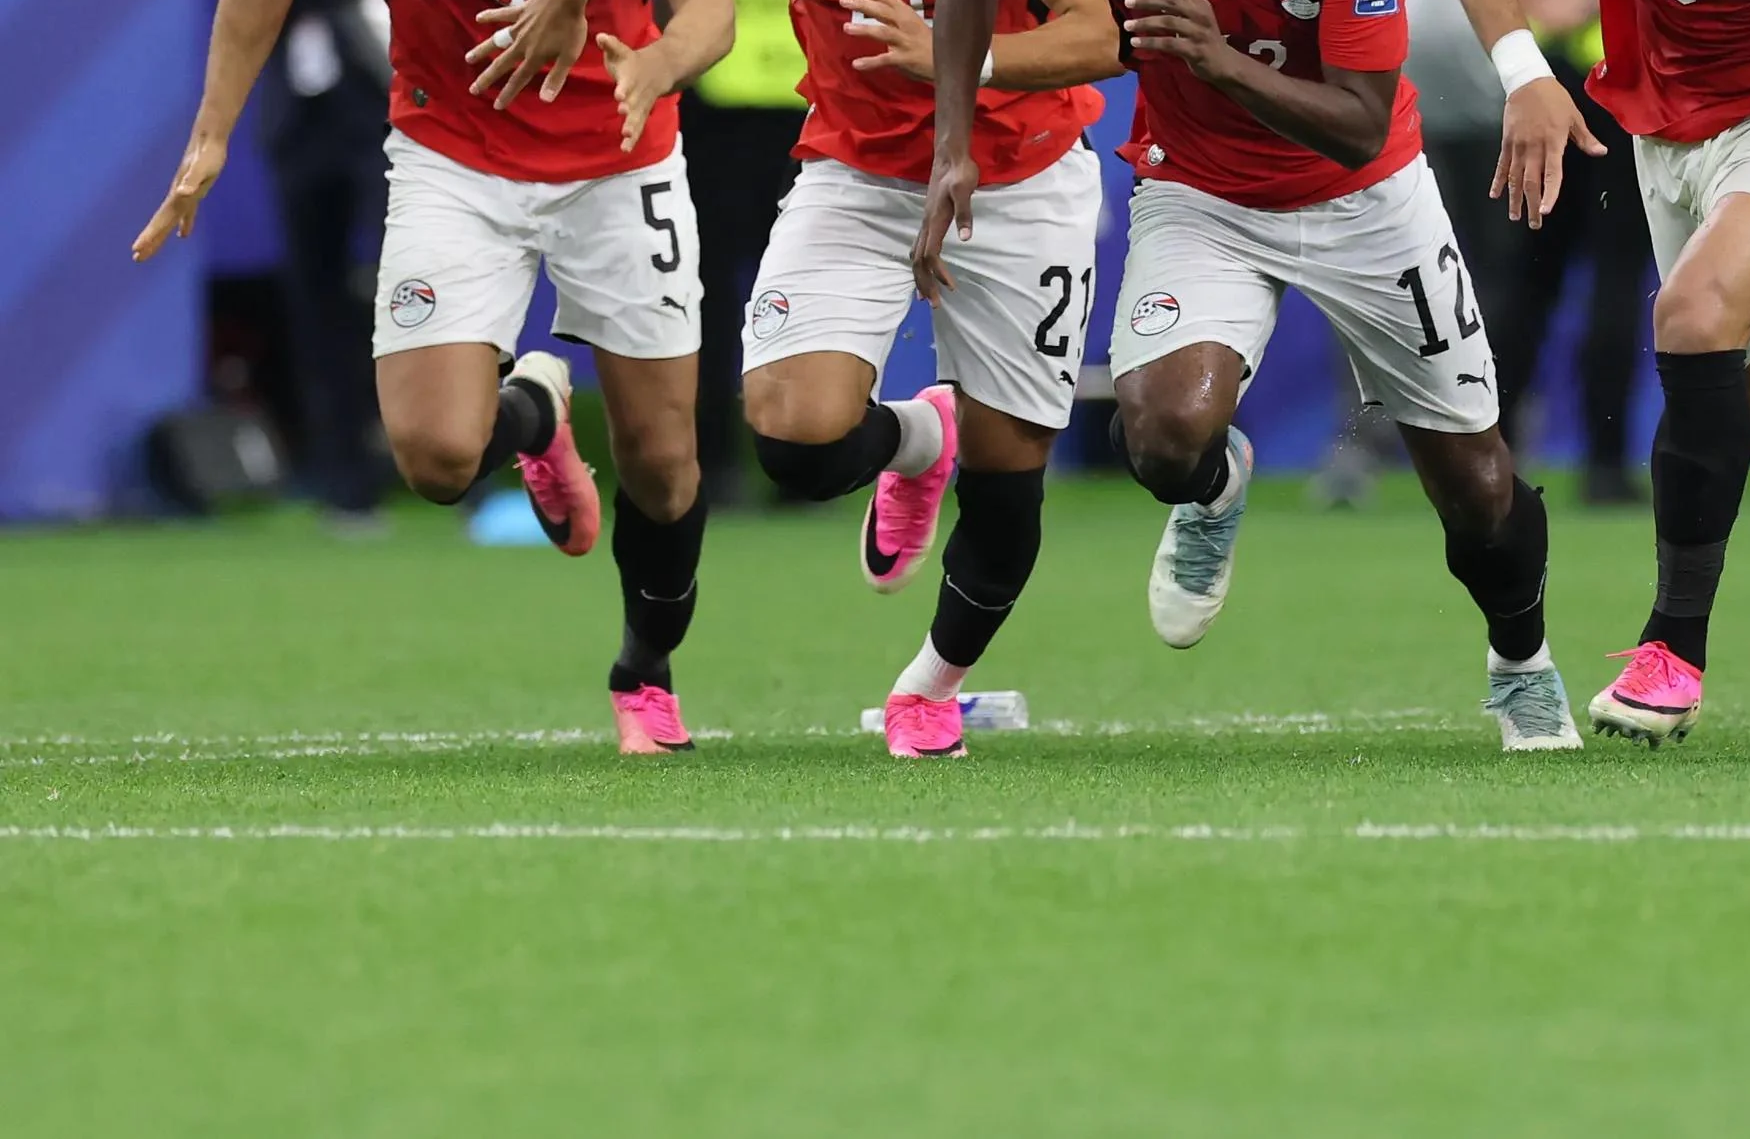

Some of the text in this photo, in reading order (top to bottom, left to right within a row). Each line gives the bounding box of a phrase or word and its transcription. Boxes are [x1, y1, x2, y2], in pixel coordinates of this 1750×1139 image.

[640, 181, 681, 274] 5
[1034, 265, 1093, 359] 21
[1396, 242, 1481, 359] 12
